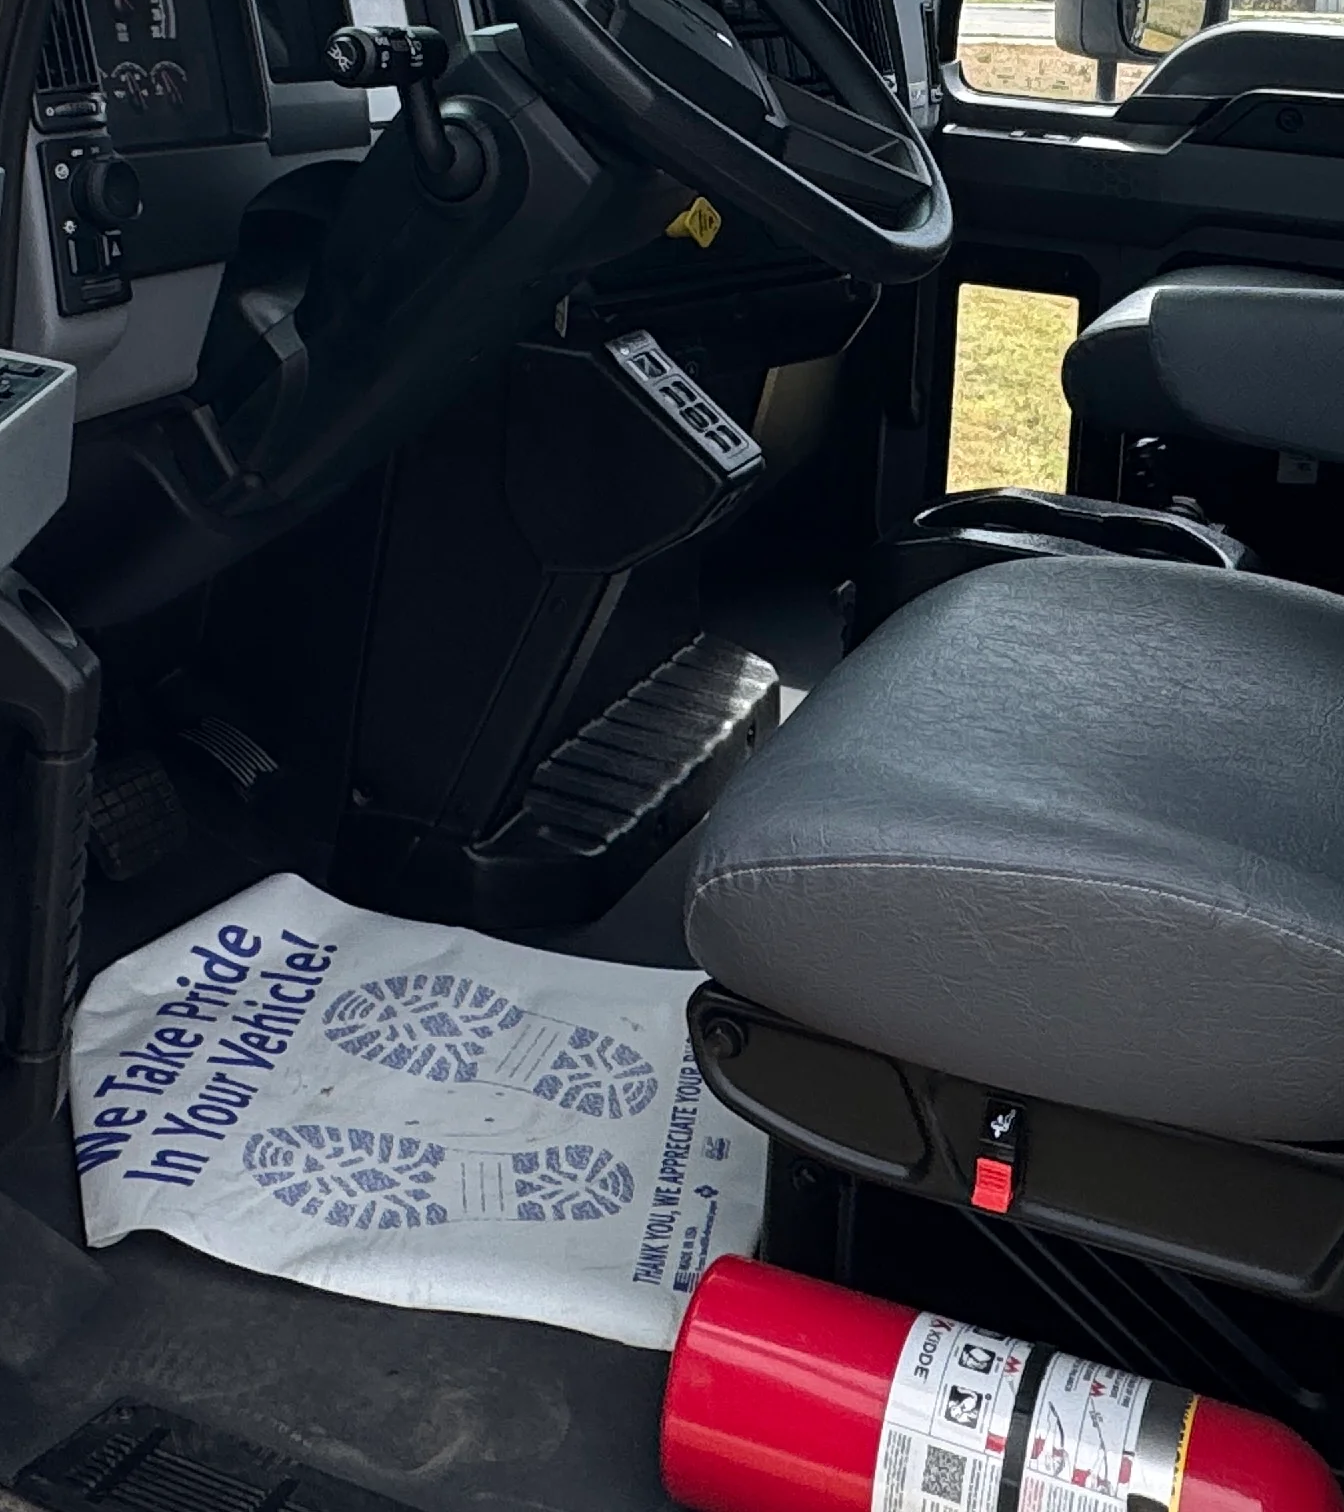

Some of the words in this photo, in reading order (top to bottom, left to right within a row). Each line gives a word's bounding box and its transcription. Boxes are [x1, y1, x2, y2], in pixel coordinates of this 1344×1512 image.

[157, 924, 262, 1022] Pride
[206, 929, 338, 1071] Vehicle!
[93, 1027, 204, 1099] Take
[675, 1065, 702, 1103] YOUR
[152, 1072, 259, 1140] Your
[75, 1106, 147, 1175] We
[123, 1149, 210, 1187] In
[659, 1105, 697, 1185] APPRECIATE
[644, 1209, 681, 1240] YOU,
[653, 1185, 682, 1207] WE
[633, 1243, 669, 1284] THANK
[914, 1329, 943, 1378] KIDDE
